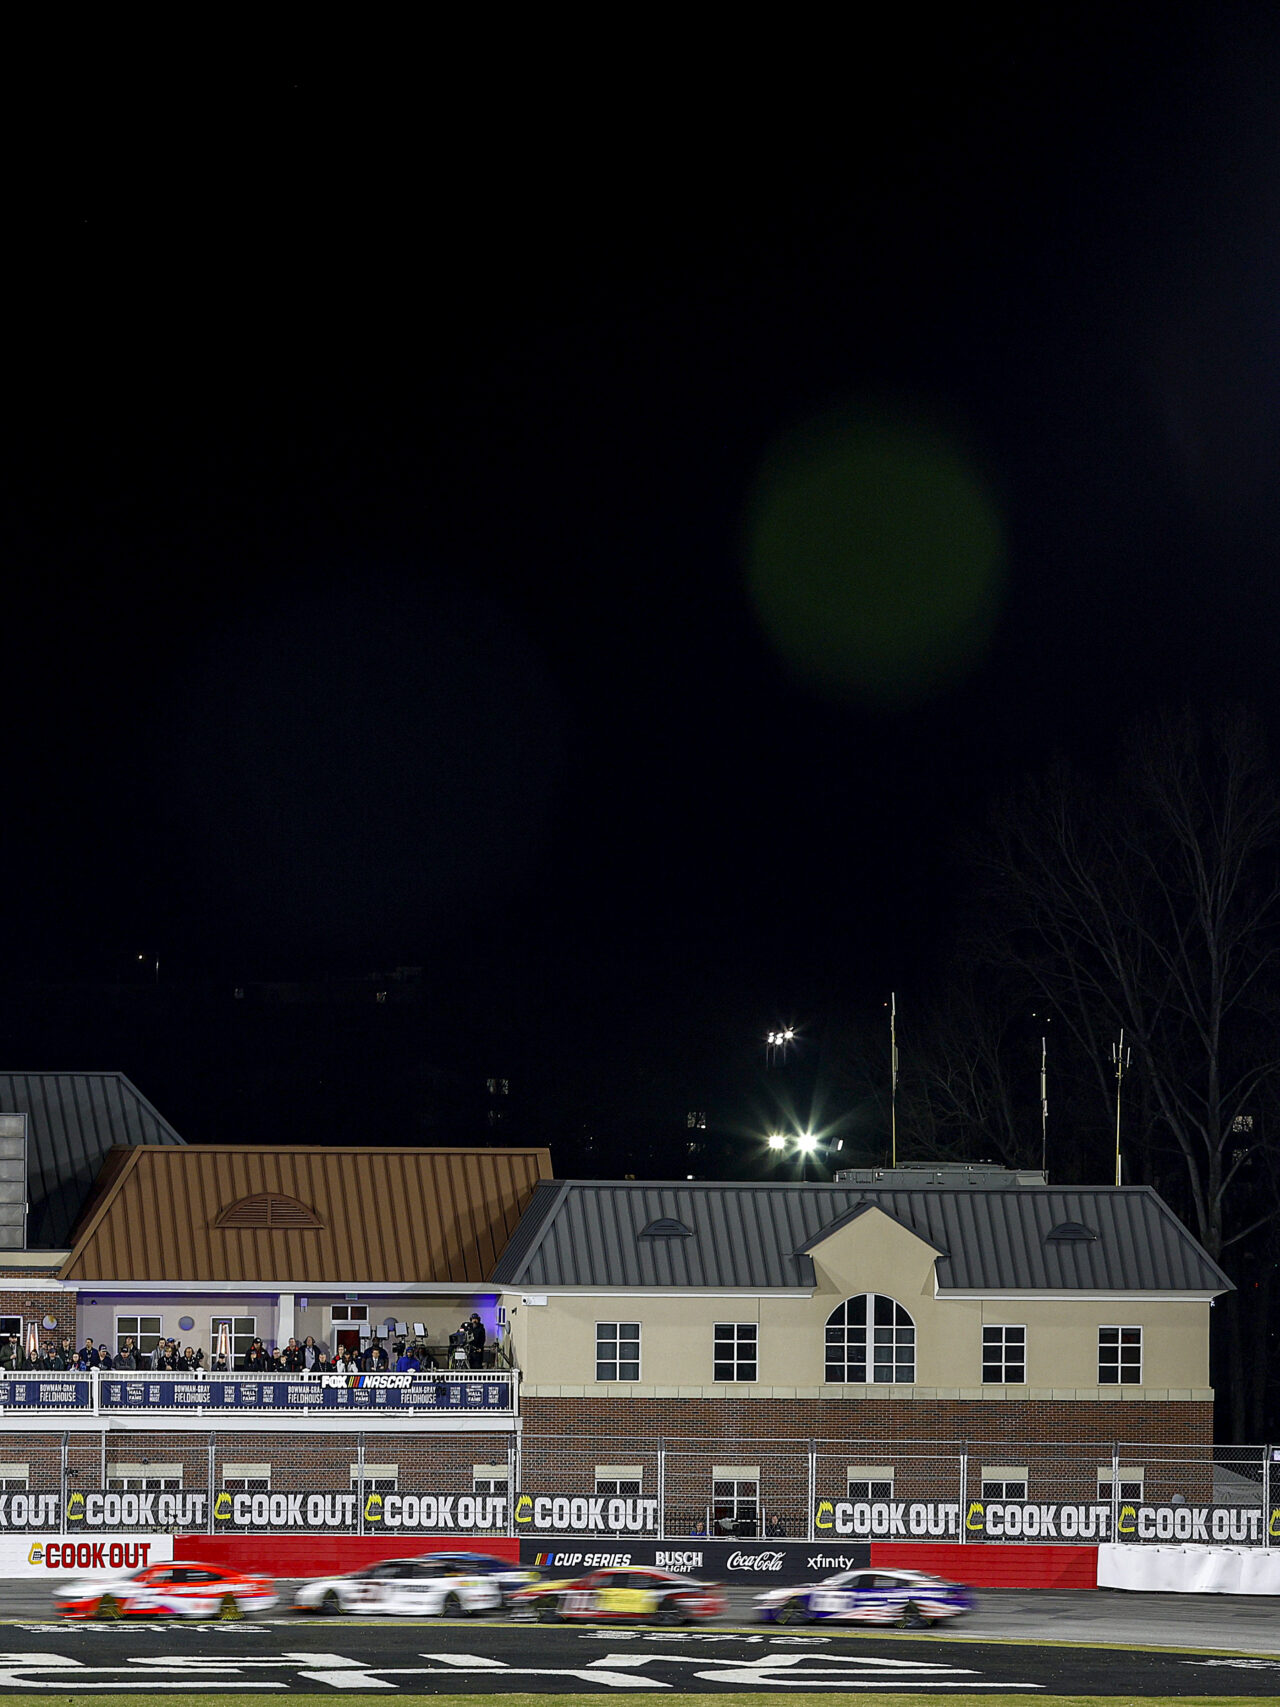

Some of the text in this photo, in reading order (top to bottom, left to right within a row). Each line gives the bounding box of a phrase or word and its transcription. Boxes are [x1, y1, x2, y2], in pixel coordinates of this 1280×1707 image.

[40, 1384, 76, 1392] BOWMAN-GRAY
[174, 1385, 210, 1393] BOWMAN-GRAY
[321, 1375, 412, 1388] FOX NASCAR
[40, 1392, 76, 1402] FIELDHOUSE
[174, 1393, 210, 1403] FIELDHOUSE
[288, 1393, 323, 1404] FIELDHOUSE
[401, 1394, 436, 1404] FIELDHOUSE
[11, 1494, 59, 1526] OUT
[85, 1493, 207, 1525] COOK OUT
[233, 1494, 356, 1526] COOK OUT
[383, 1495, 507, 1529] COOK OUT
[533, 1497, 658, 1530] COOK OUT
[835, 1503, 959, 1535] COOK OUT
[985, 1504, 1110, 1538] COOK OUT
[1137, 1507, 1261, 1541] COOK OUT
[45, 1543, 151, 1568] COOK OUT
[554, 1553, 632, 1567] CUP SERIES
[655, 1551, 703, 1567] BUSCH
[726, 1551, 787, 1571] Coca-Cola
[806, 1554, 855, 1571] xfinity
[665, 1565, 693, 1573] LIGHT
